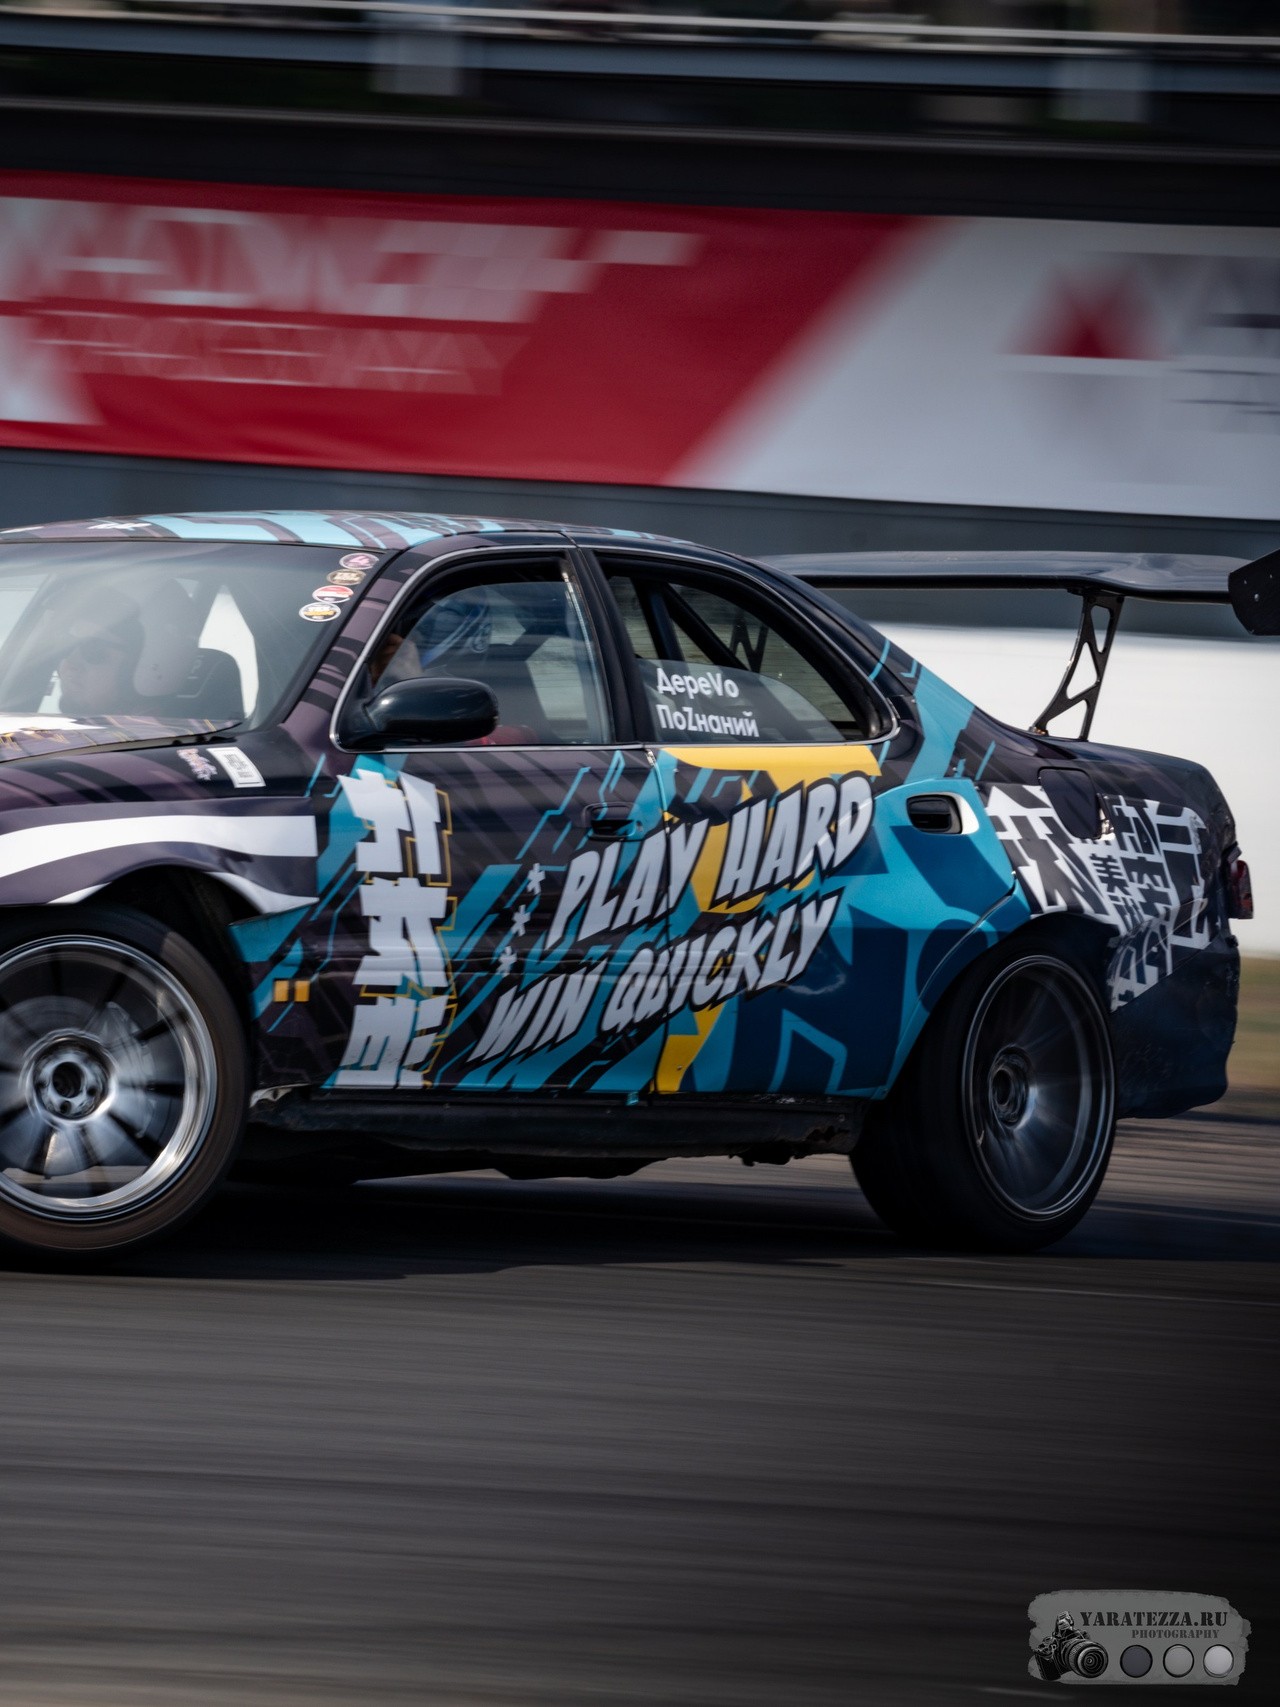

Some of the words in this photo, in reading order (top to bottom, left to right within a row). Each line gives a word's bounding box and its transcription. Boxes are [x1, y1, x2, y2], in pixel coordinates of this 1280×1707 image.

[547, 819, 709, 949] PLAY
[713, 777, 873, 901] HARD
[467, 966, 603, 1062] WIN
[603, 896, 838, 1032] QUICKLY
